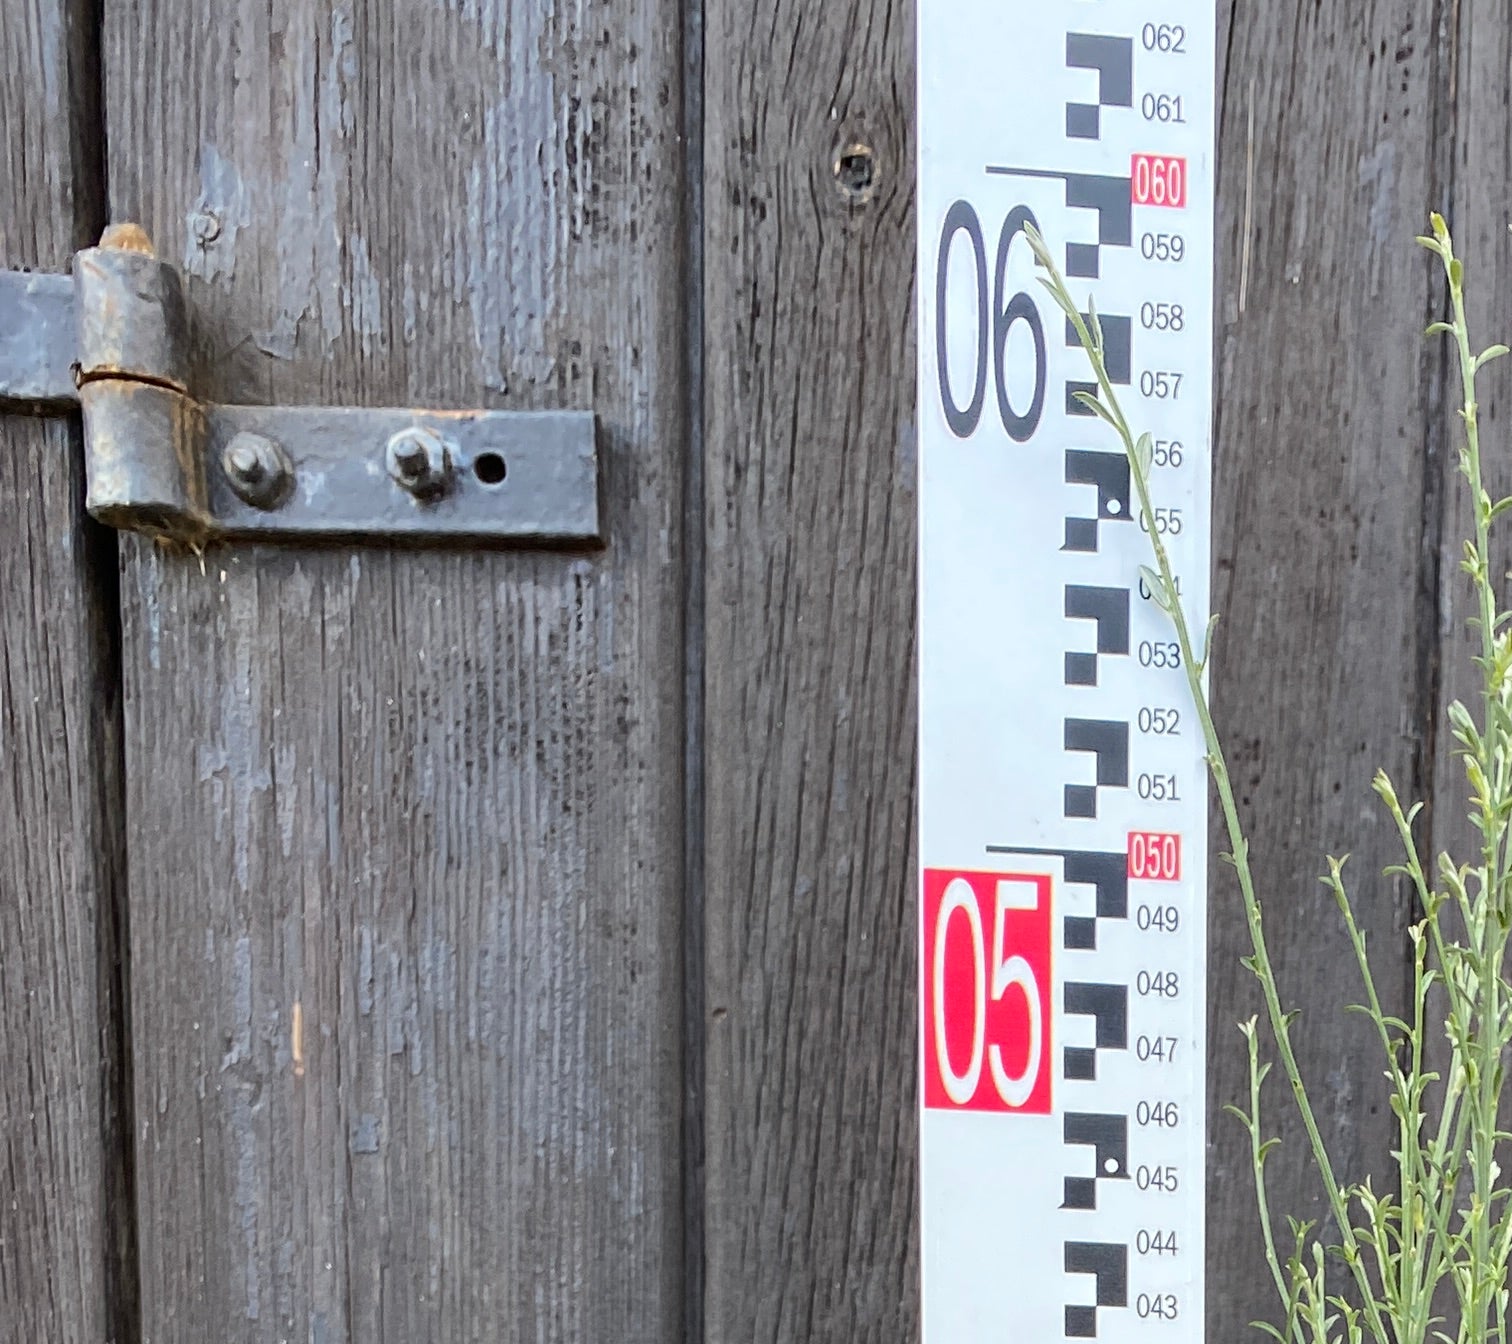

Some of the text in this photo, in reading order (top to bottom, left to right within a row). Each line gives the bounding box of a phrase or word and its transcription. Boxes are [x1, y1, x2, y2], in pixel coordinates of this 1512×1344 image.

[1142, 23, 1185, 53] 062
[1142, 93, 1185, 123] 061
[1136, 157, 1181, 205] 060
[1141, 233, 1184, 262] 059
[936, 199, 1046, 442] 06
[1141, 302, 1183, 331] 058
[1141, 371, 1183, 399] 057
[1150, 440, 1183, 468] 56
[1139, 641, 1181, 669] 053
[1138, 707, 1180, 735] 052
[1138, 773, 1180, 800] 051
[1132, 834, 1177, 879] 050
[1137, 905, 1178, 932] 049
[934, 877, 1042, 1107] 05
[1137, 971, 1178, 997] 048
[1137, 1036, 1178, 1062] 047
[1137, 1101, 1178, 1127] 046
[1137, 1165, 1177, 1191] 045
[1137, 1230, 1178, 1256] 044
[1137, 1293, 1177, 1319] 043
